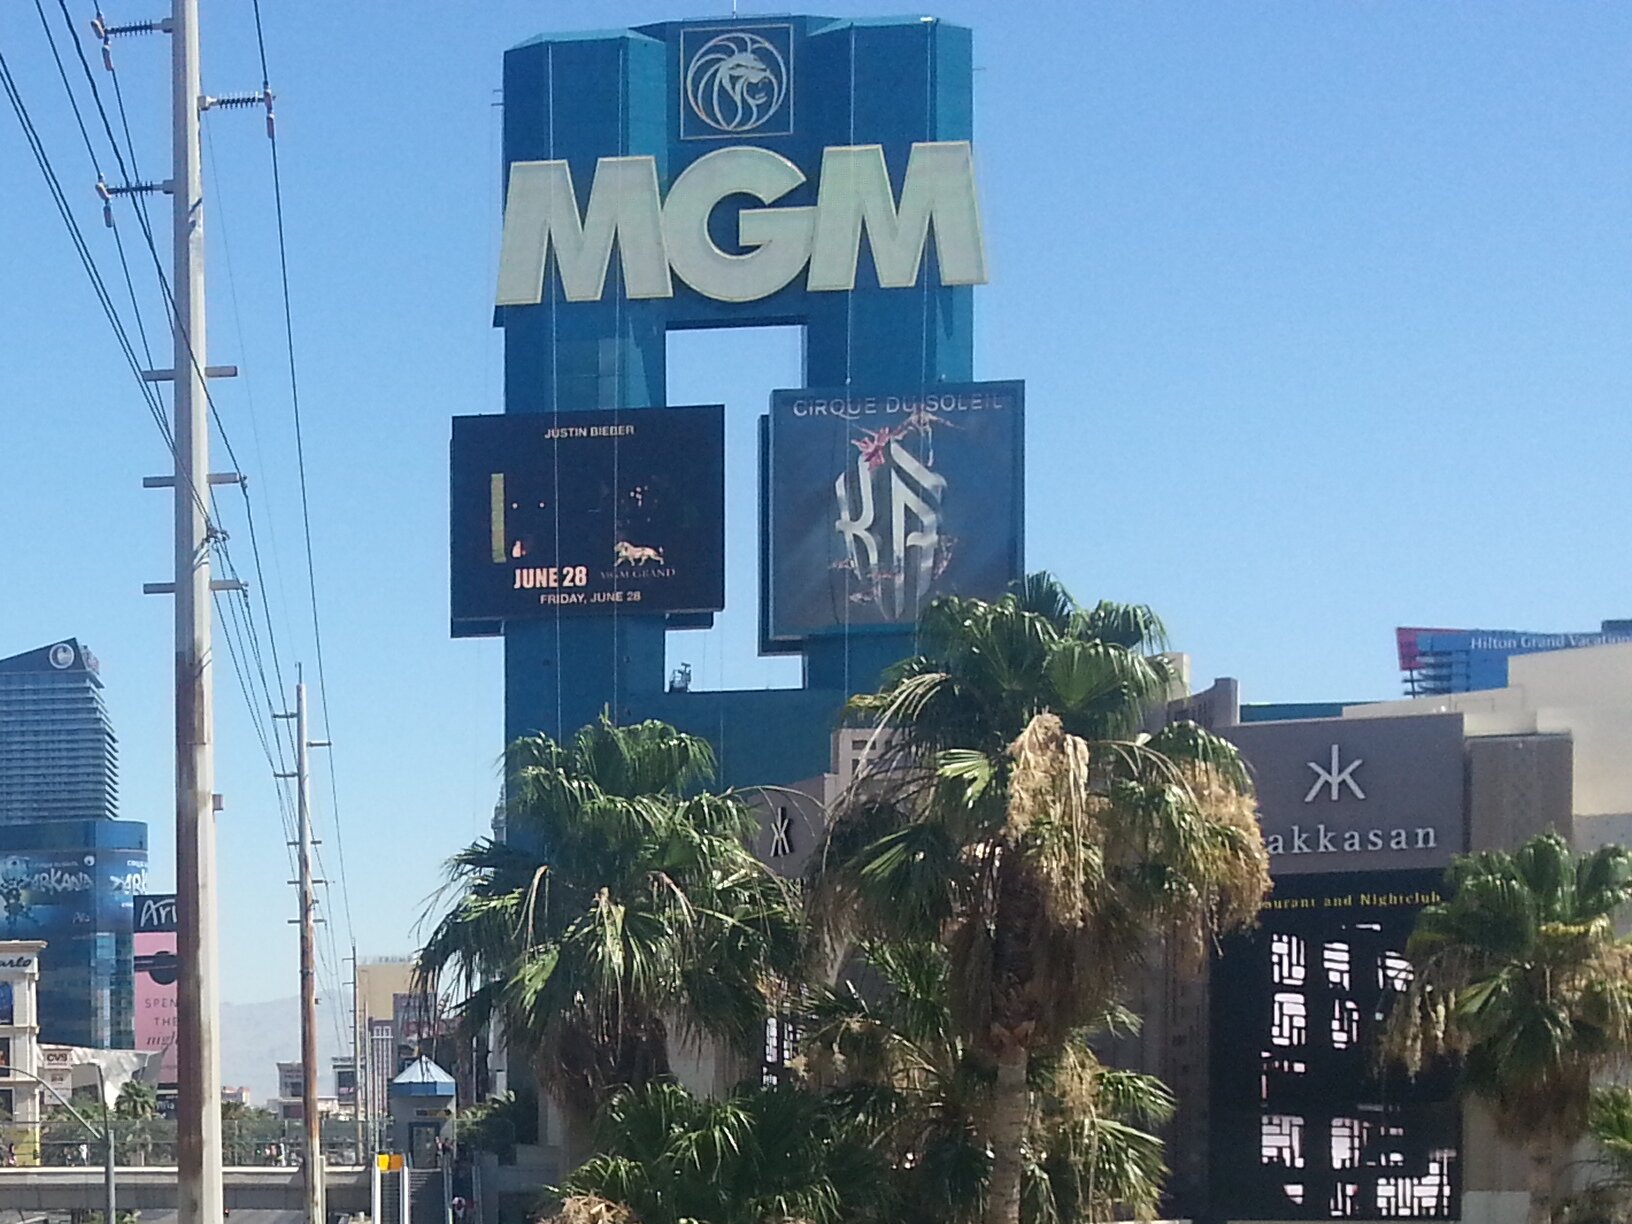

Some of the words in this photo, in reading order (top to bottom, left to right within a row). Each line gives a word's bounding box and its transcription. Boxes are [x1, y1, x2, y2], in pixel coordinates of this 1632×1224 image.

[495, 141, 989, 305] MGM
[793, 397, 877, 419] CIRQUE
[886, 396, 912, 413] DU
[925, 394, 1004, 412] SOLEIL
[544, 427, 587, 439] JUSTIN
[590, 424, 635, 437] BIEBER
[514, 567, 558, 589] JUNE
[562, 566, 587, 587] 28
[632, 568, 676, 579] GRAND
[540, 593, 587, 604] FRIDAY,
[590, 592, 624, 603] JUNE
[626, 591, 641, 602] 28
[1470, 636, 1517, 650] Hilton
[1520, 634, 1565, 648] Grand
[1267, 824, 1437, 855] akkasan
[1323, 894, 1352, 907] and
[1360, 890, 1441, 907] Nightclub
[140, 899, 178, 928] Ari
[144, 998, 178, 1009] SPEN
[47, 1053, 68, 1062] CVS
